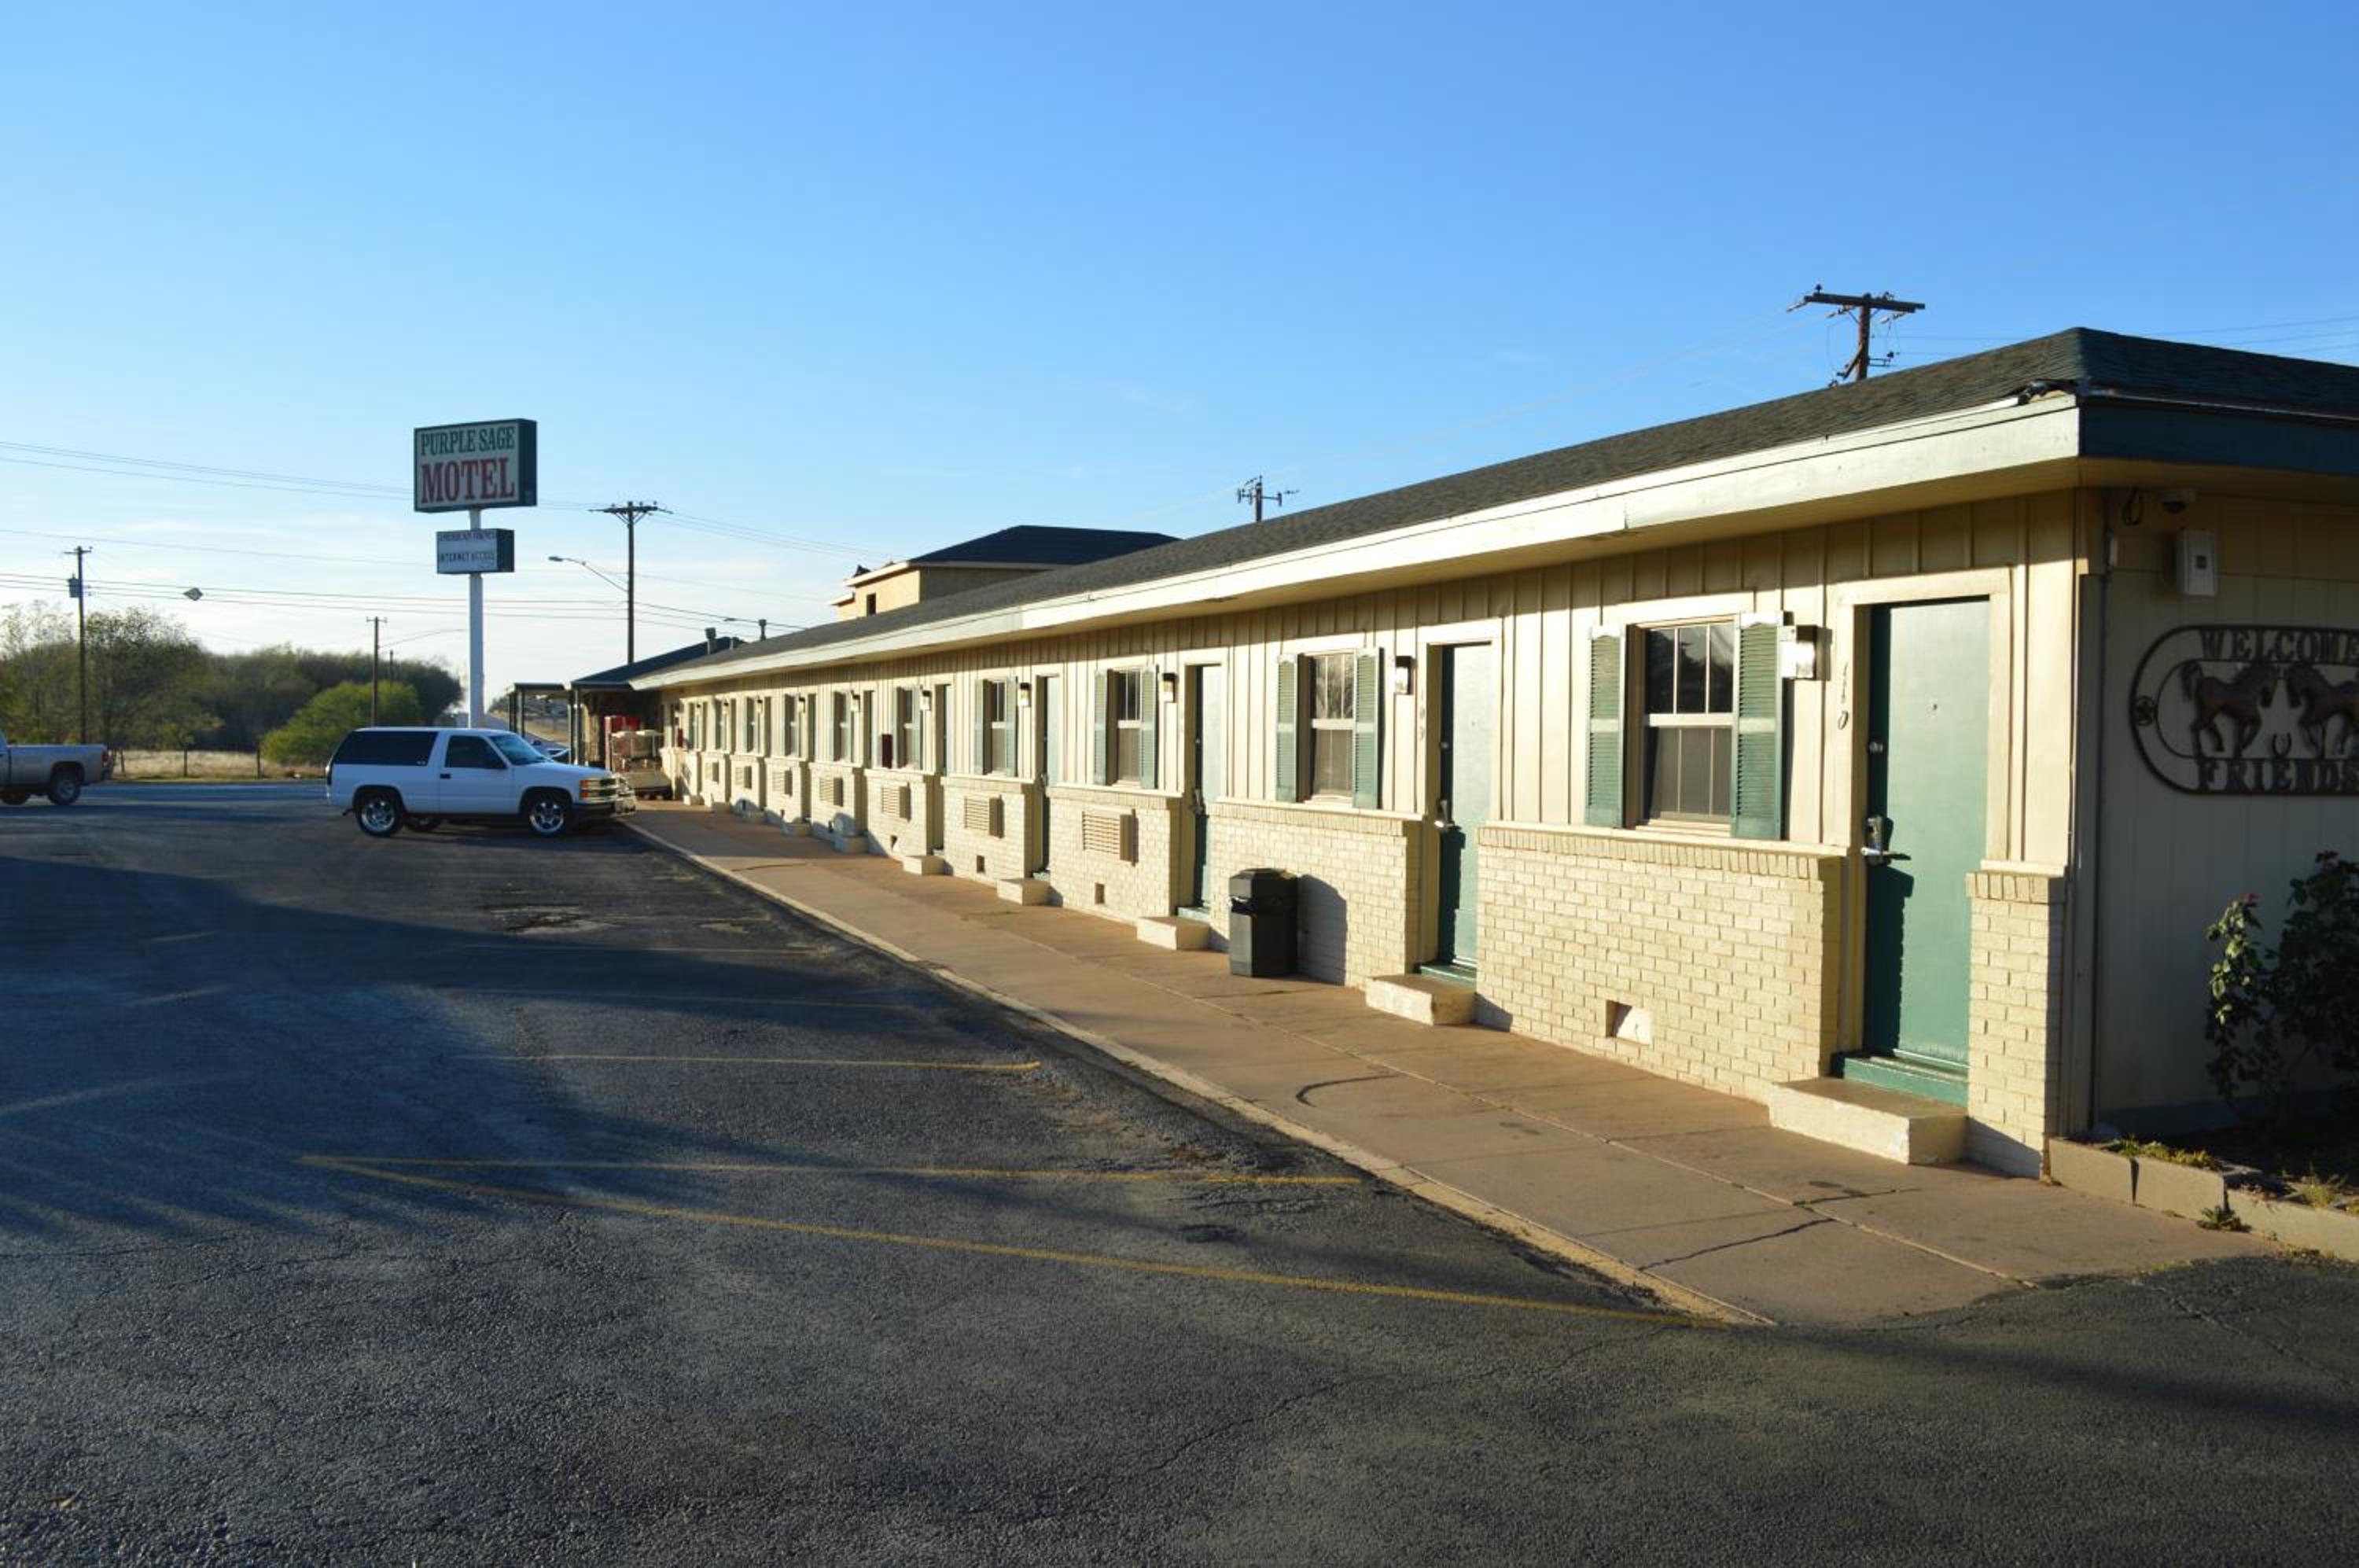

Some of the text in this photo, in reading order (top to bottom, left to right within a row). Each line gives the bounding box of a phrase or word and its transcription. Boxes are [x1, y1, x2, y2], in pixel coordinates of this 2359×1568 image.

[421, 425, 515, 457] PURPLE SAGE
[421, 457, 515, 504] MOTEL
[2199, 629, 2359, 662] WELCOME
[2199, 758, 2359, 793] FRIENDS
